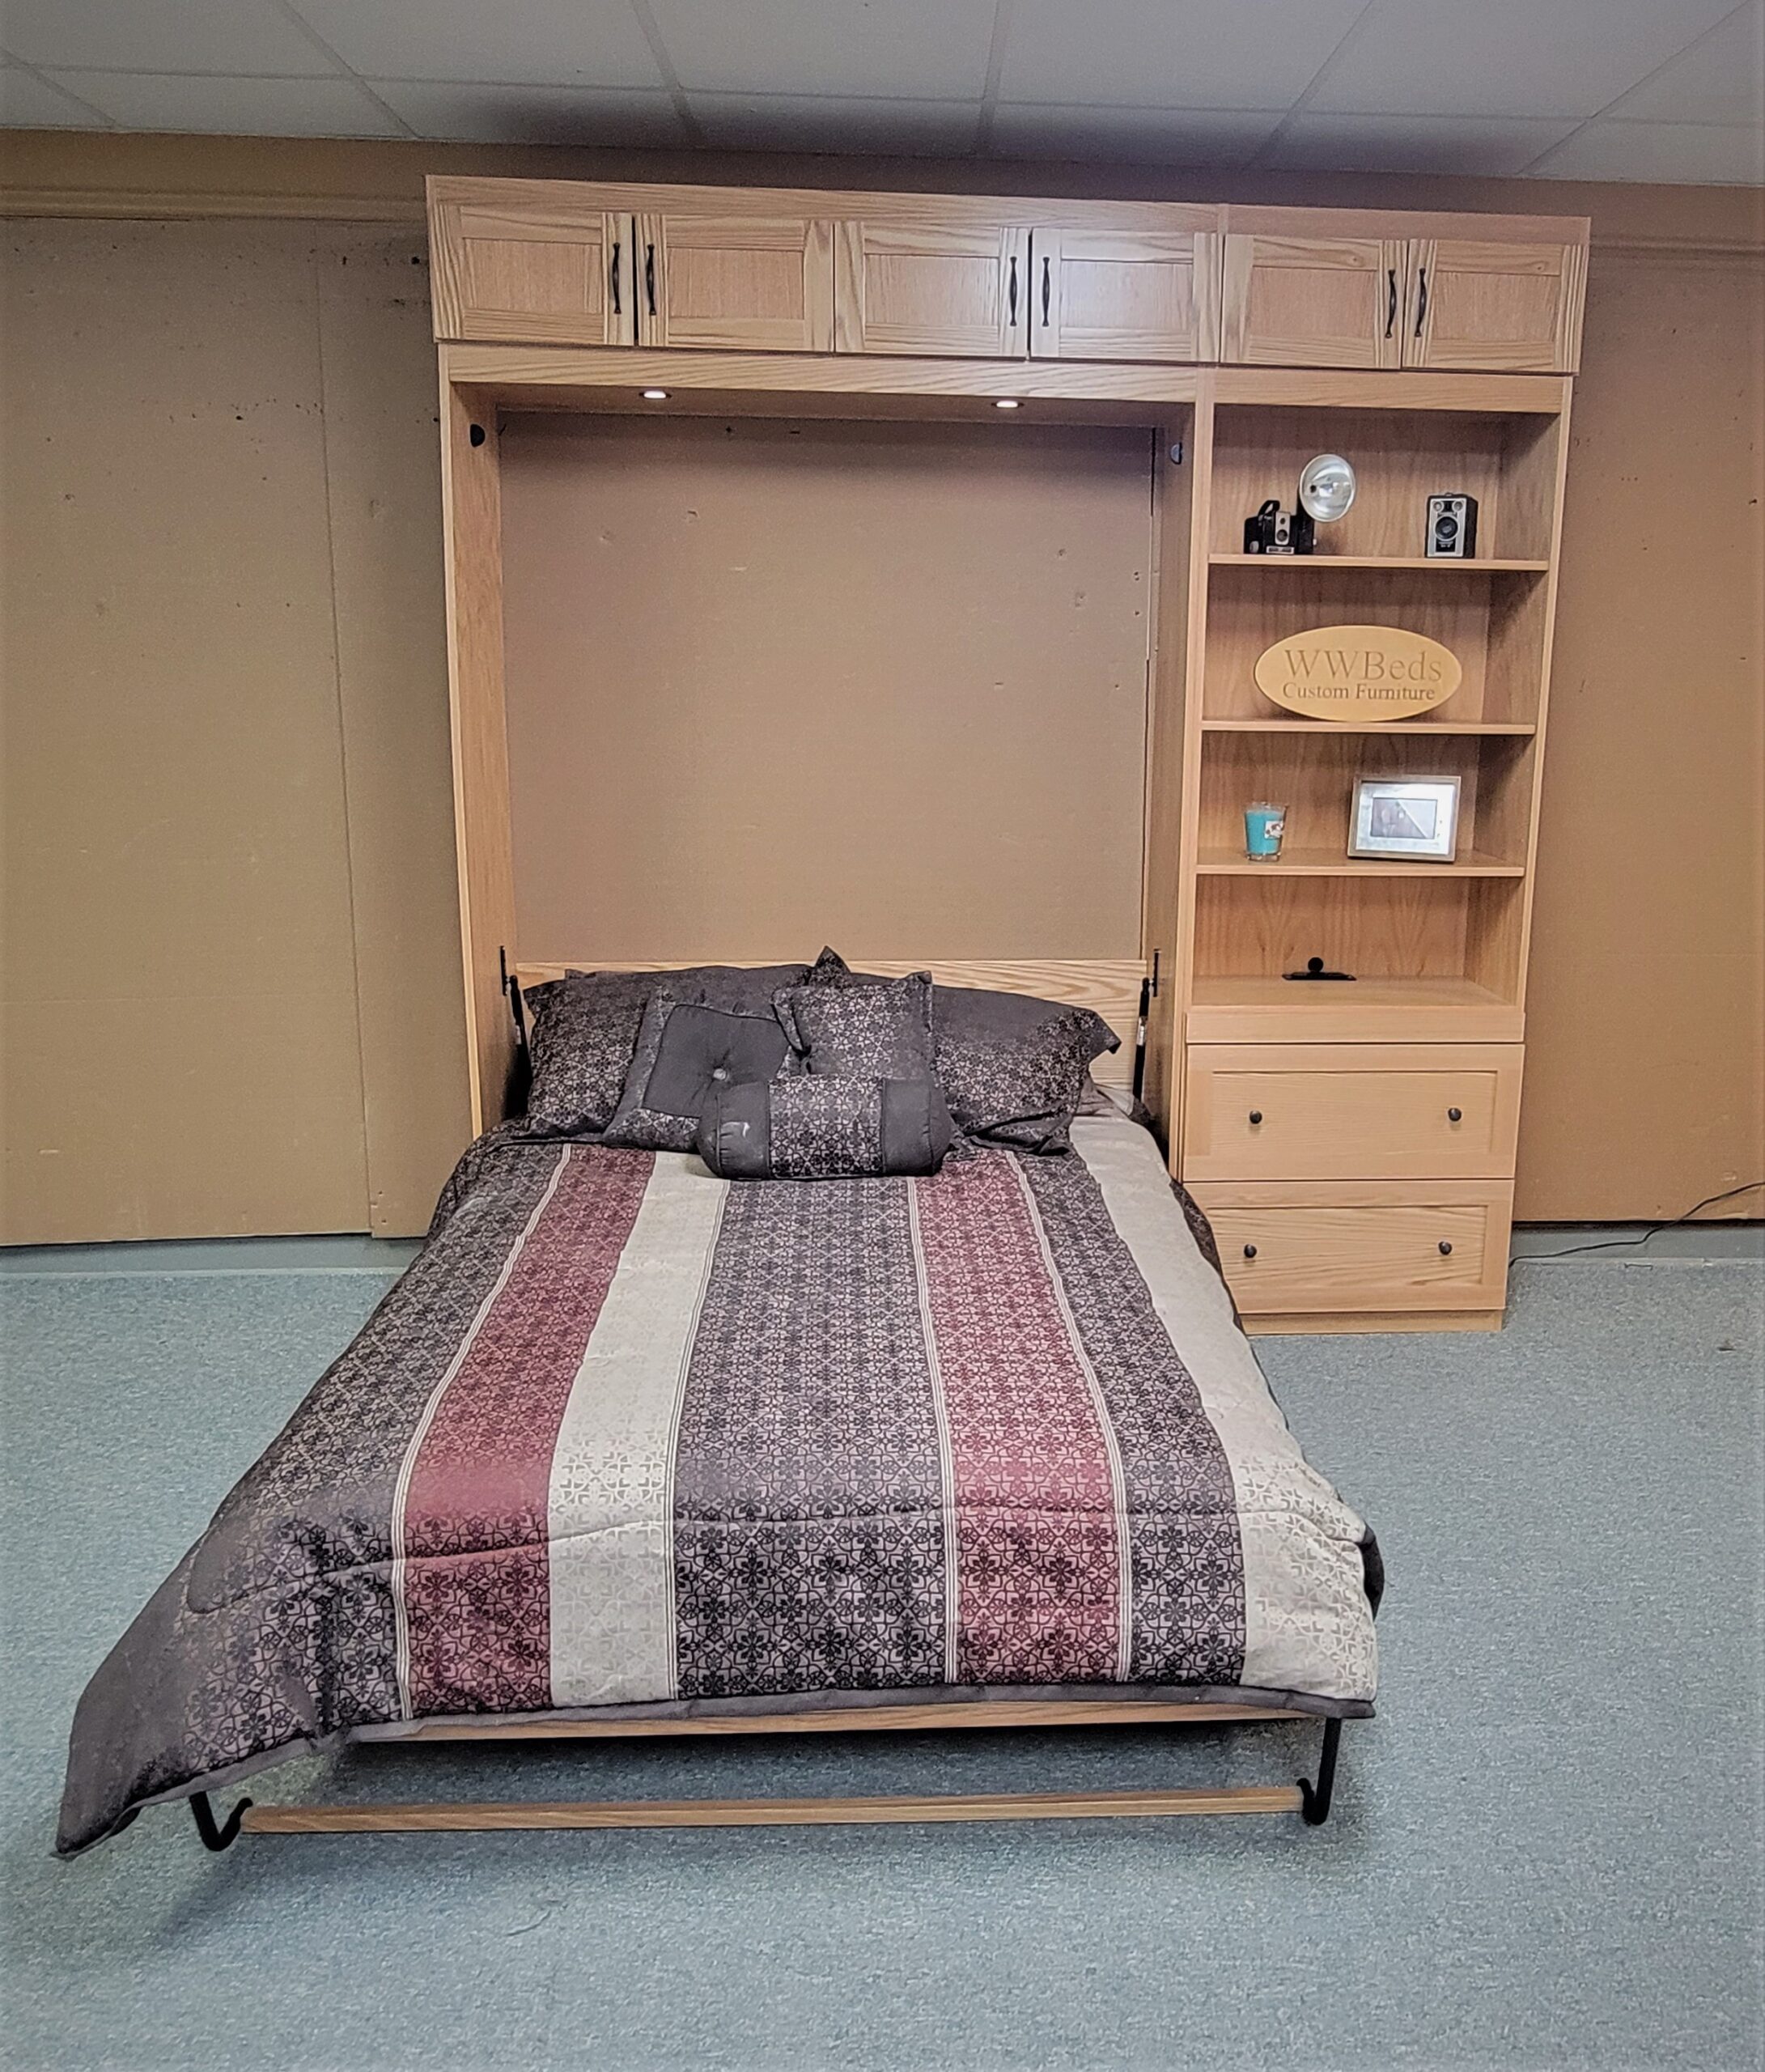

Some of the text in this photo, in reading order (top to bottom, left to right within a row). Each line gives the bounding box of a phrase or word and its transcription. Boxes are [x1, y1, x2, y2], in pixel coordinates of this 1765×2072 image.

[1284, 649, 1442, 681] WWBeds
[1283, 682, 1436, 701] Custom Furniture
